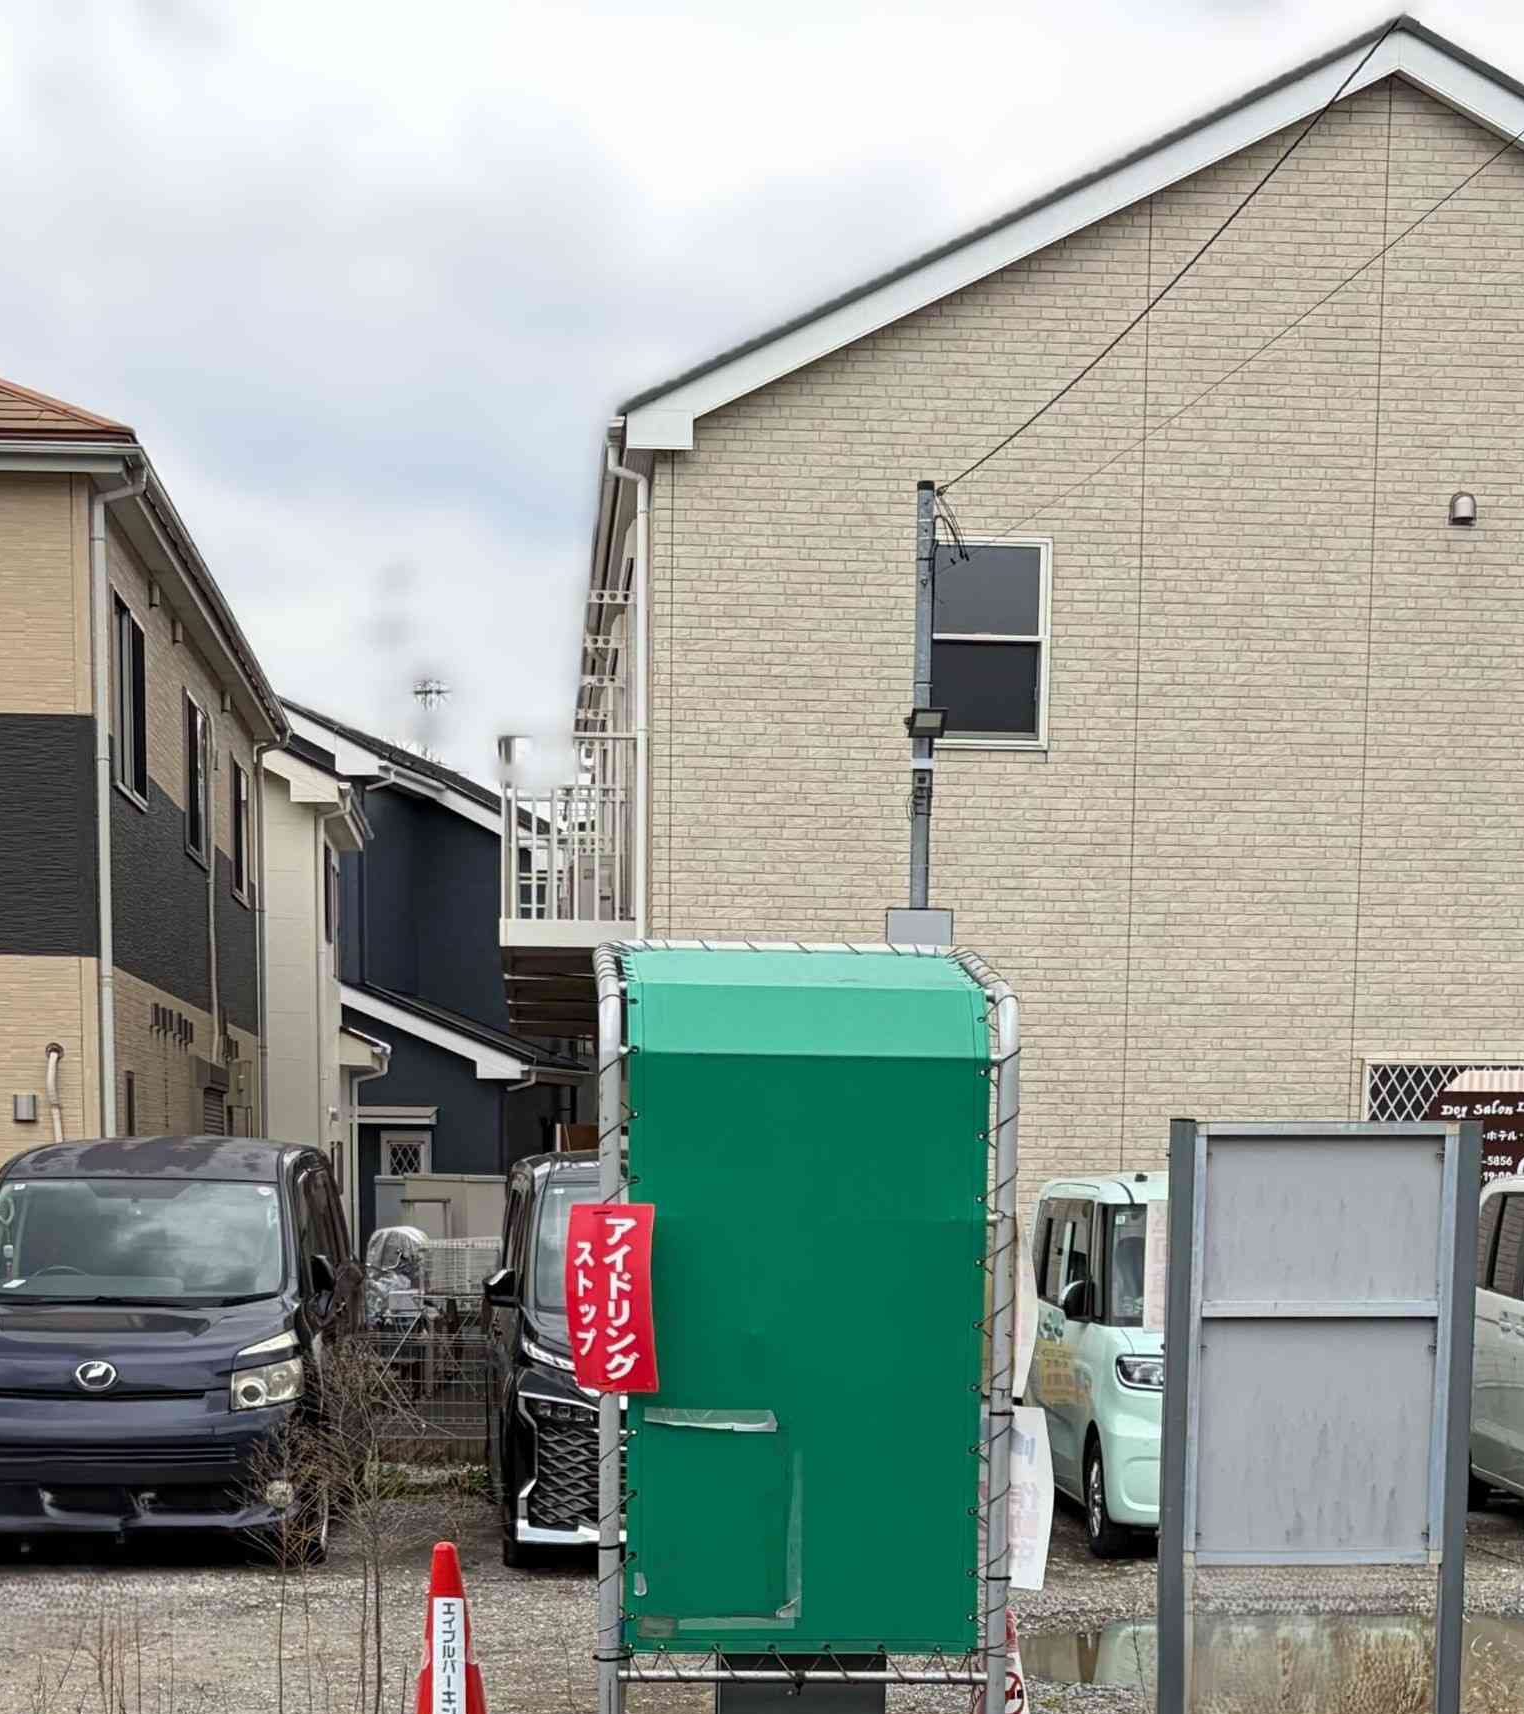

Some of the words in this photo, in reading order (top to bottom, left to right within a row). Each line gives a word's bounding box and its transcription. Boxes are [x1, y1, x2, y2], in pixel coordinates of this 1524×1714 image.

[1440, 1103, 1467, 1118] Dog
[1473, 1099, 1514, 1116] Salon
[573, 1241, 598, 1356] ストップ
[602, 1217, 640, 1381] アイドリング
